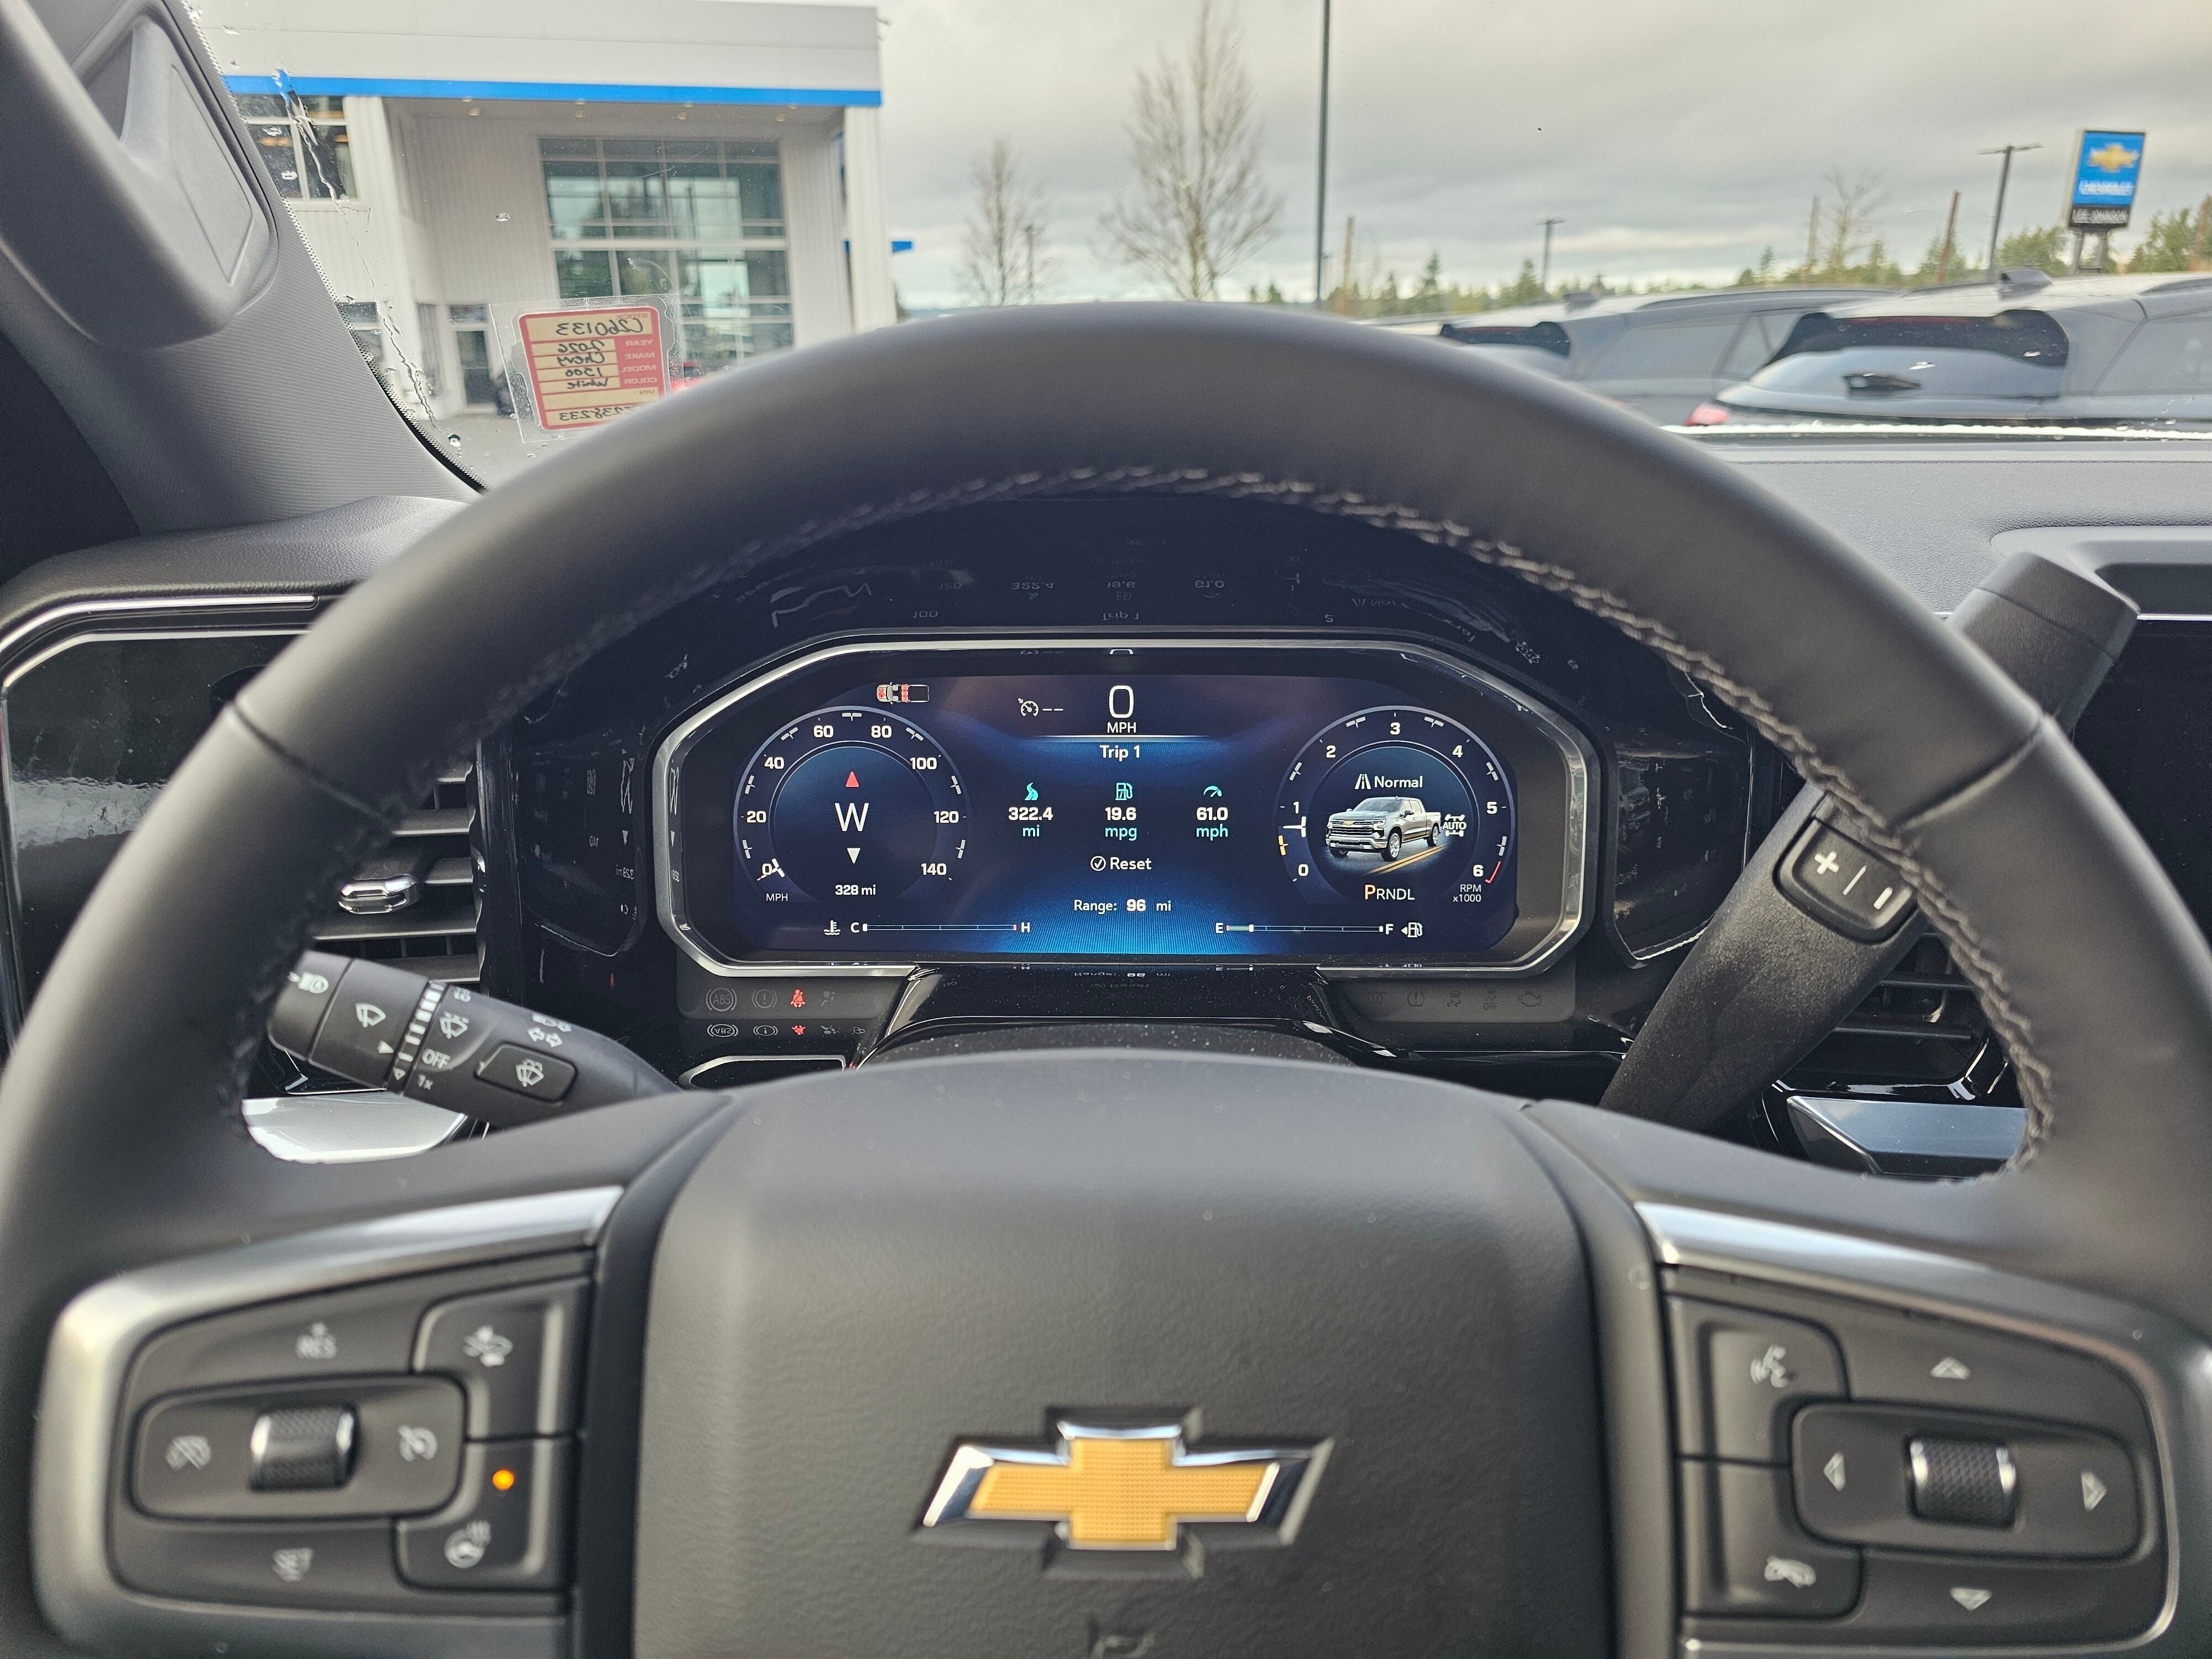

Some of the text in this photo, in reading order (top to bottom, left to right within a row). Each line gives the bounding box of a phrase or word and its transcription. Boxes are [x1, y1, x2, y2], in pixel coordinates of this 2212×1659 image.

[1109, 685, 1134, 718] 0
[814, 726, 833, 737] 60
[872, 726, 891, 738] 80
[1107, 722, 1136, 733] MPH
[1390, 722, 1400, 734] 3
[1100, 745, 1141, 761] Trip 1
[1326, 745, 1335, 758] 2
[1453, 745, 1463, 758] 4
[764, 756, 785, 770] 40
[910, 757, 937, 769] 100
[1375, 776, 1423, 787] Normal
[1009, 807, 1053, 820] 322.4
[1105, 807, 1136, 820] 19.6
[1197, 807, 1228, 820] 61.0
[1293, 802, 1299, 813] 1
[1487, 802, 1497, 814] 5
[747, 811, 767, 823] 20
[835, 803, 869, 831] W
[934, 811, 959, 823] 120
[1023, 825, 1040, 837] mi
[1442, 820, 1467, 831] AUTO
[1105, 827, 1137, 841] mpg
[1196, 823, 1228, 841] mph
[1110, 857, 1151, 869] Reset
[761, 863, 773, 876] 0
[921, 863, 947, 876] 140
[1298, 864, 1308, 876] 0
[1473, 865, 1483, 877] 6
[835, 884, 875, 895] 328 mi
[1459, 884, 1481, 893] RPM
[1453, 894, 1481, 902] x1000
[1074, 899, 1171, 914] Range: 96 mi
[851, 922, 859, 933] C
[1020, 922, 1031, 933] H
[1215, 923, 1224, 934] E
[1386, 924, 1394, 935] F
[713, 994, 731, 1005] ABS
[421, 1048, 451, 1069] OFF
